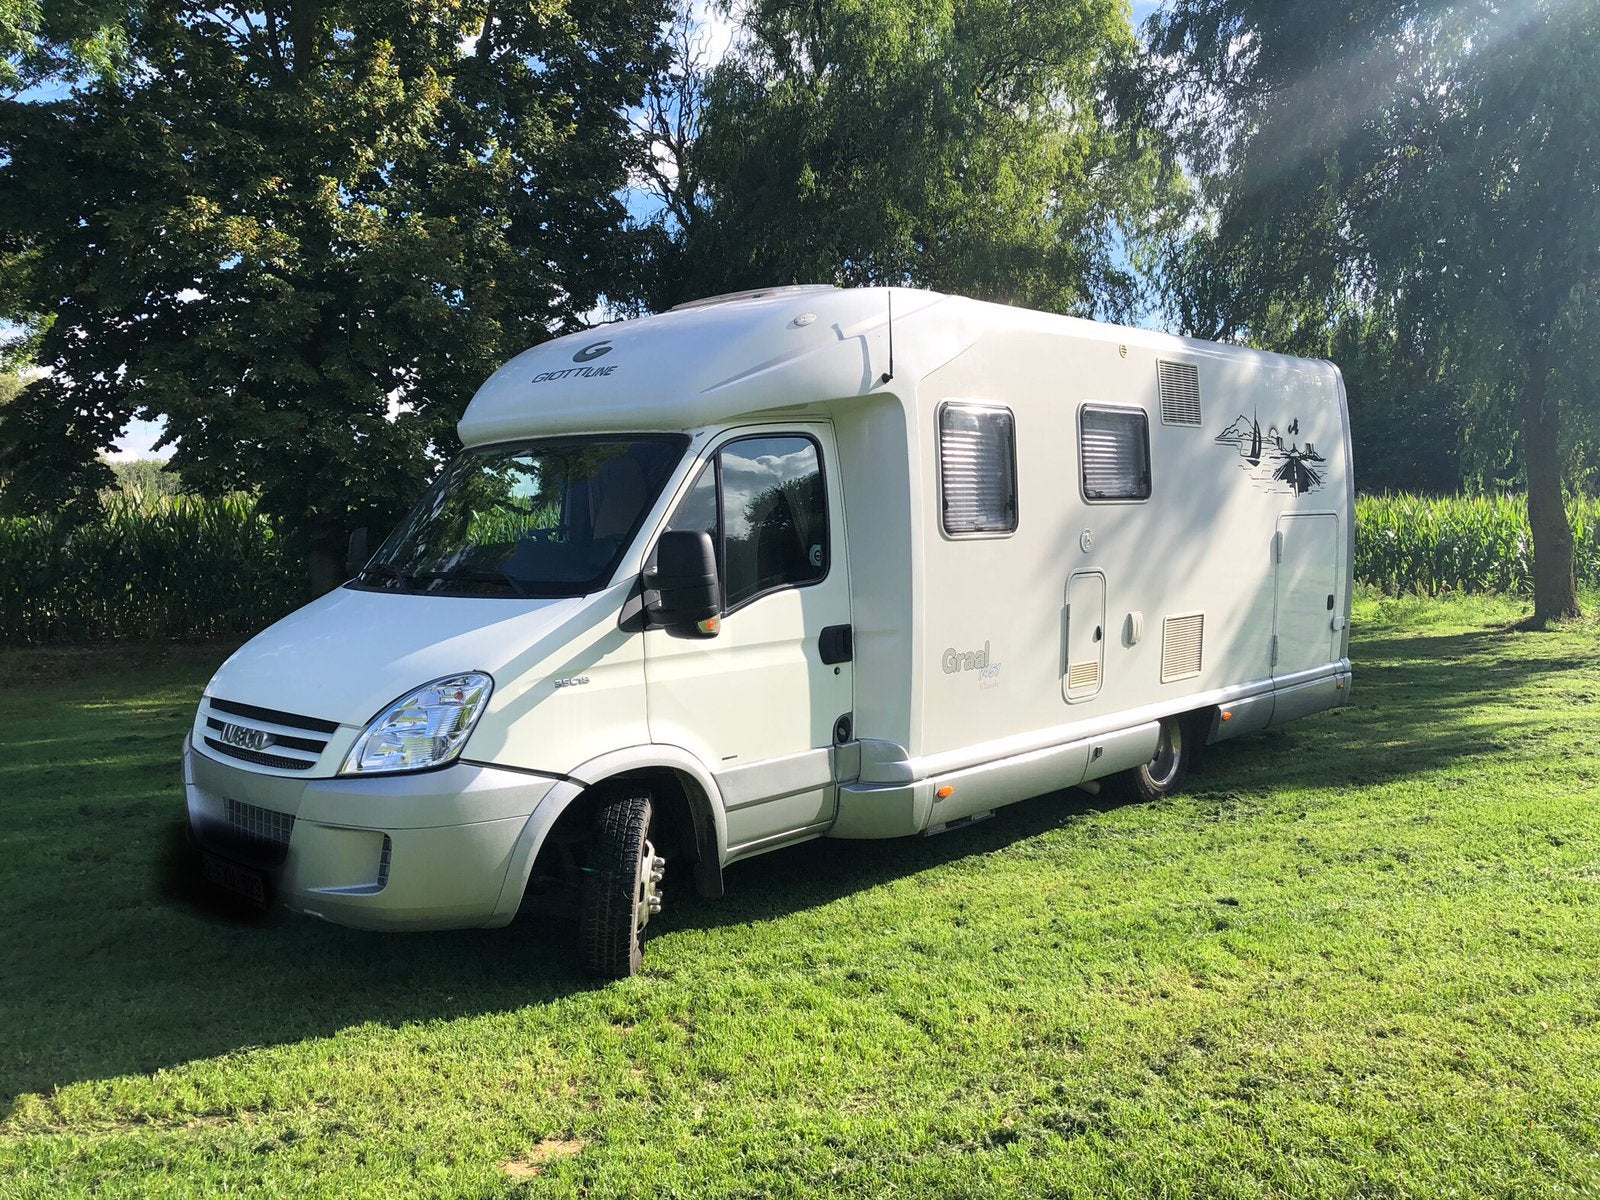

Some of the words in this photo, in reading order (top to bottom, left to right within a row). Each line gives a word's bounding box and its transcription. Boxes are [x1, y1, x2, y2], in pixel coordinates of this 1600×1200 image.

[531, 365, 618, 384] GIOTTILINE
[942, 639, 990, 674] Graal
[220, 723, 268, 750] IVECO
